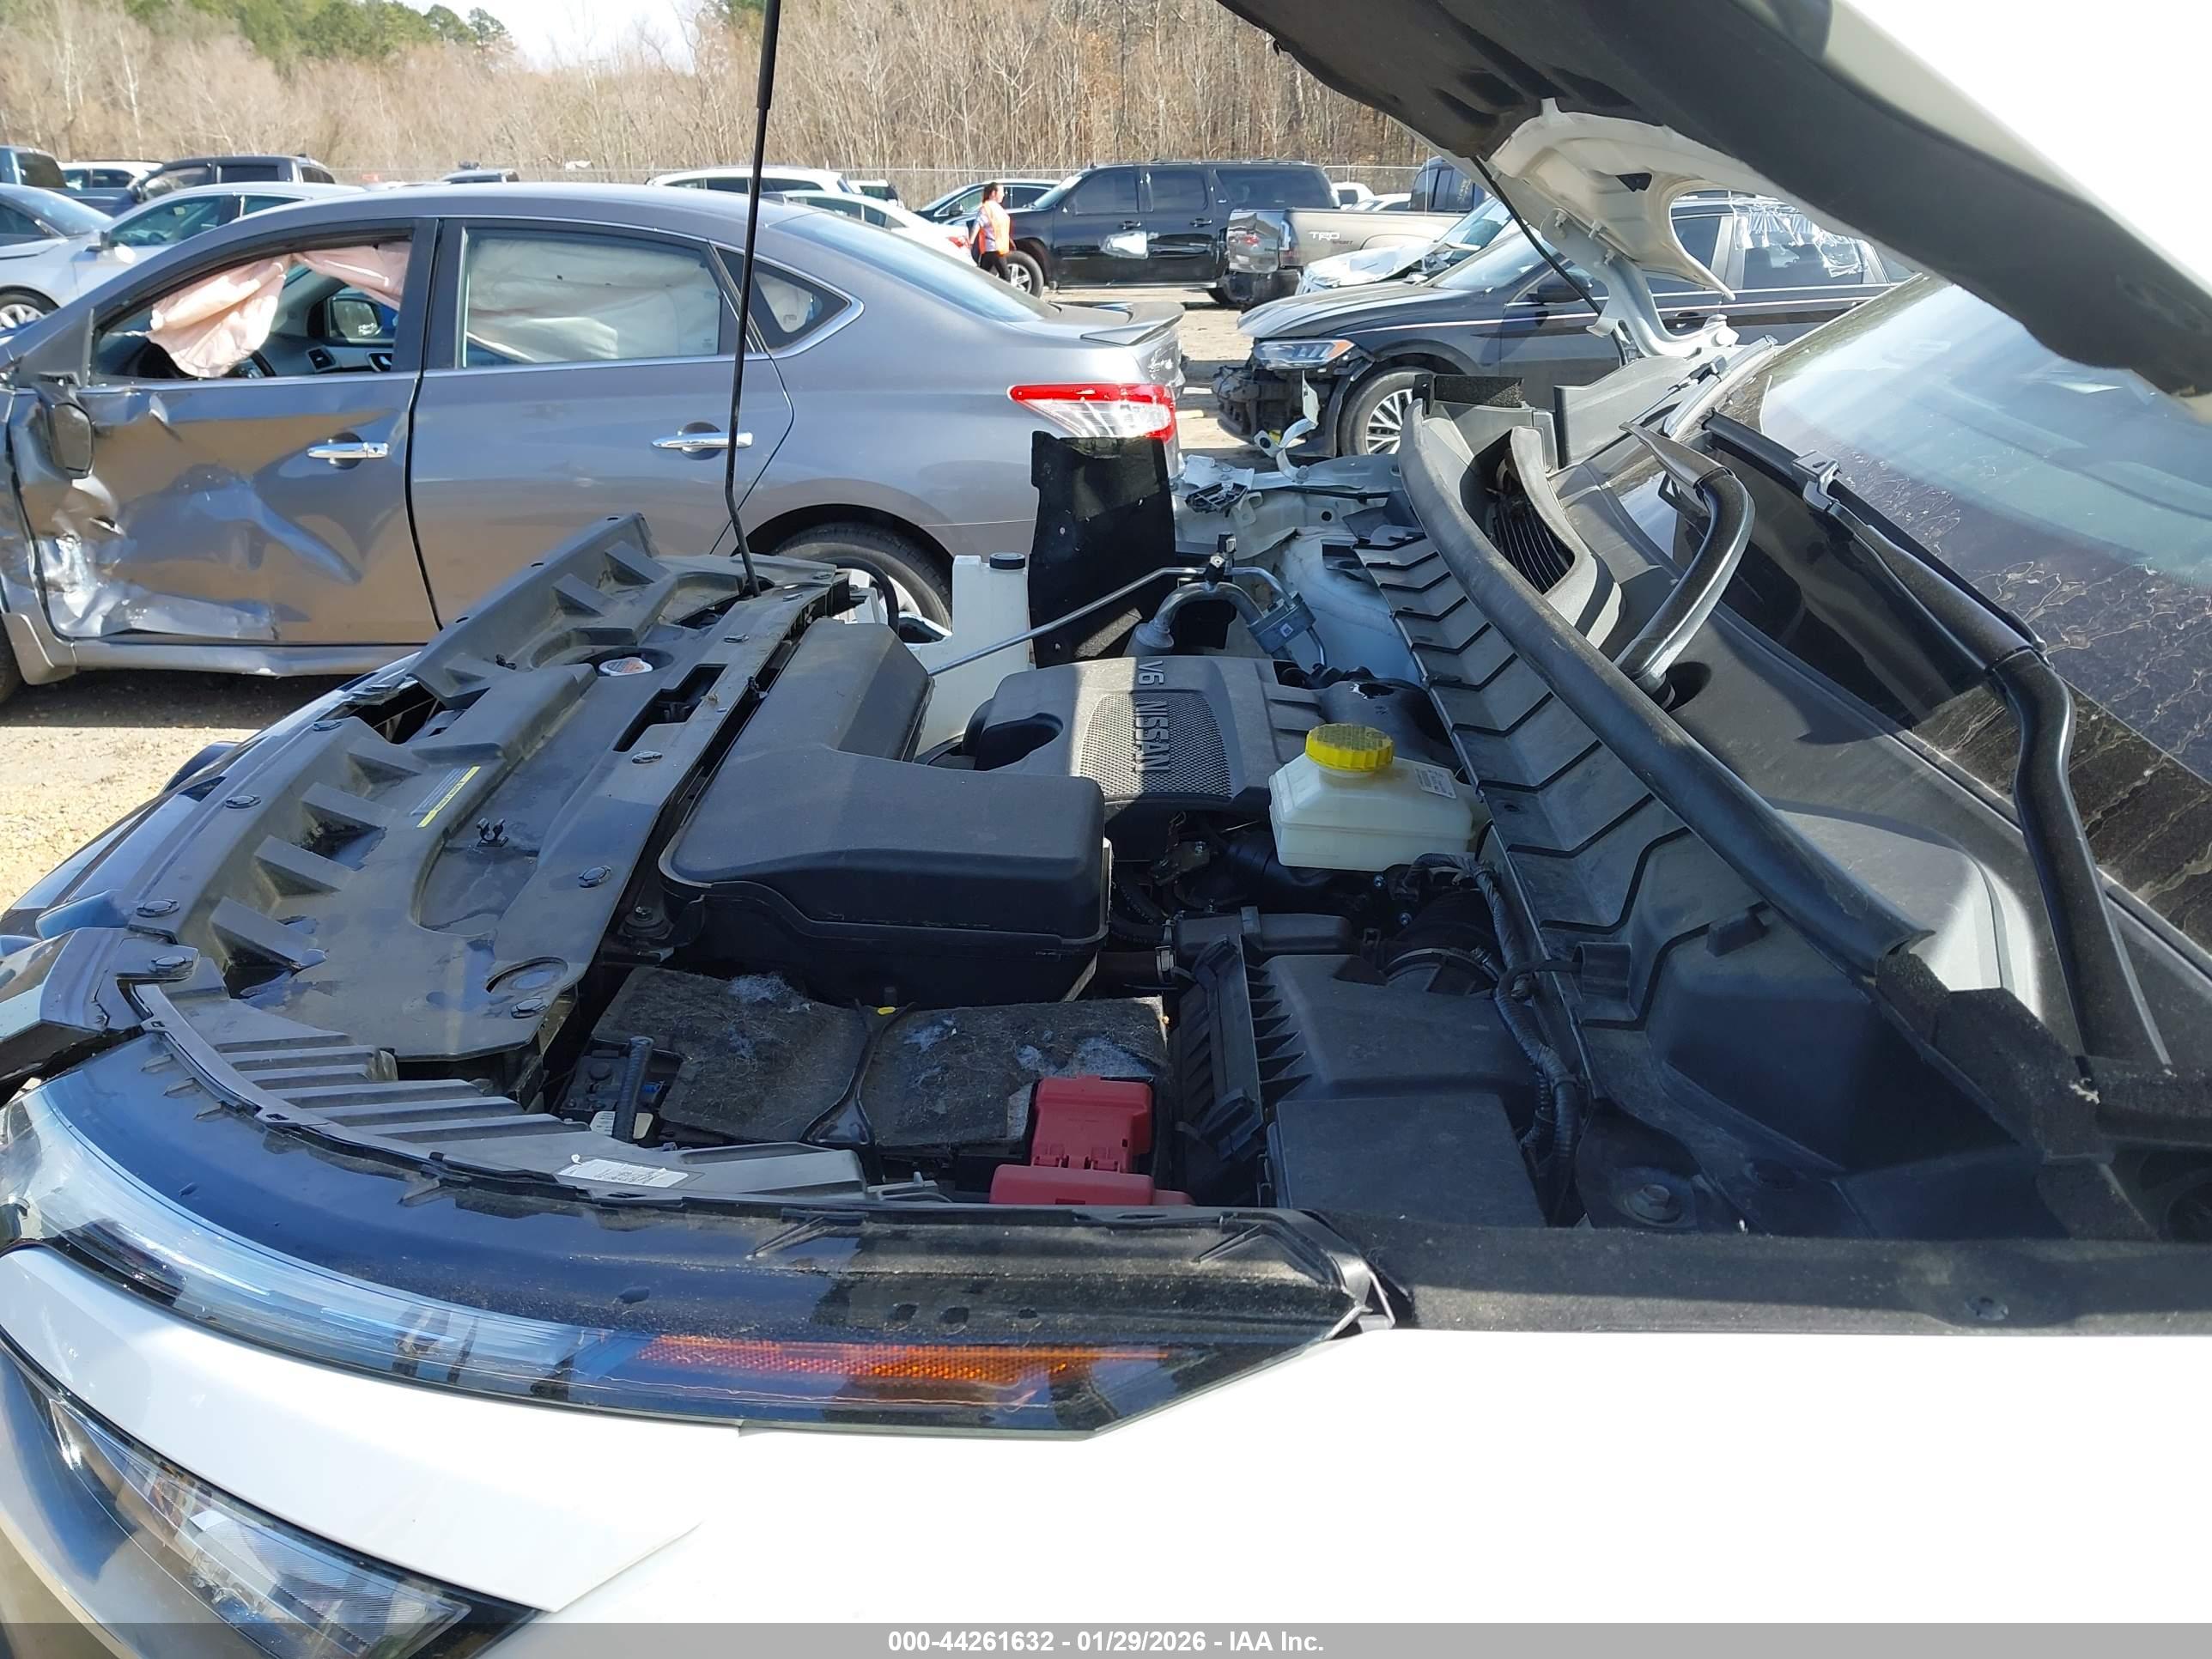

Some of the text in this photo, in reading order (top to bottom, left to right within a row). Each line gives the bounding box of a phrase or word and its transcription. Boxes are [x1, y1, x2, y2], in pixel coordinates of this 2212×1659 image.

[1308, 231, 1340, 241] TRD
[1135, 659, 1170, 772] V6 NISSAN
